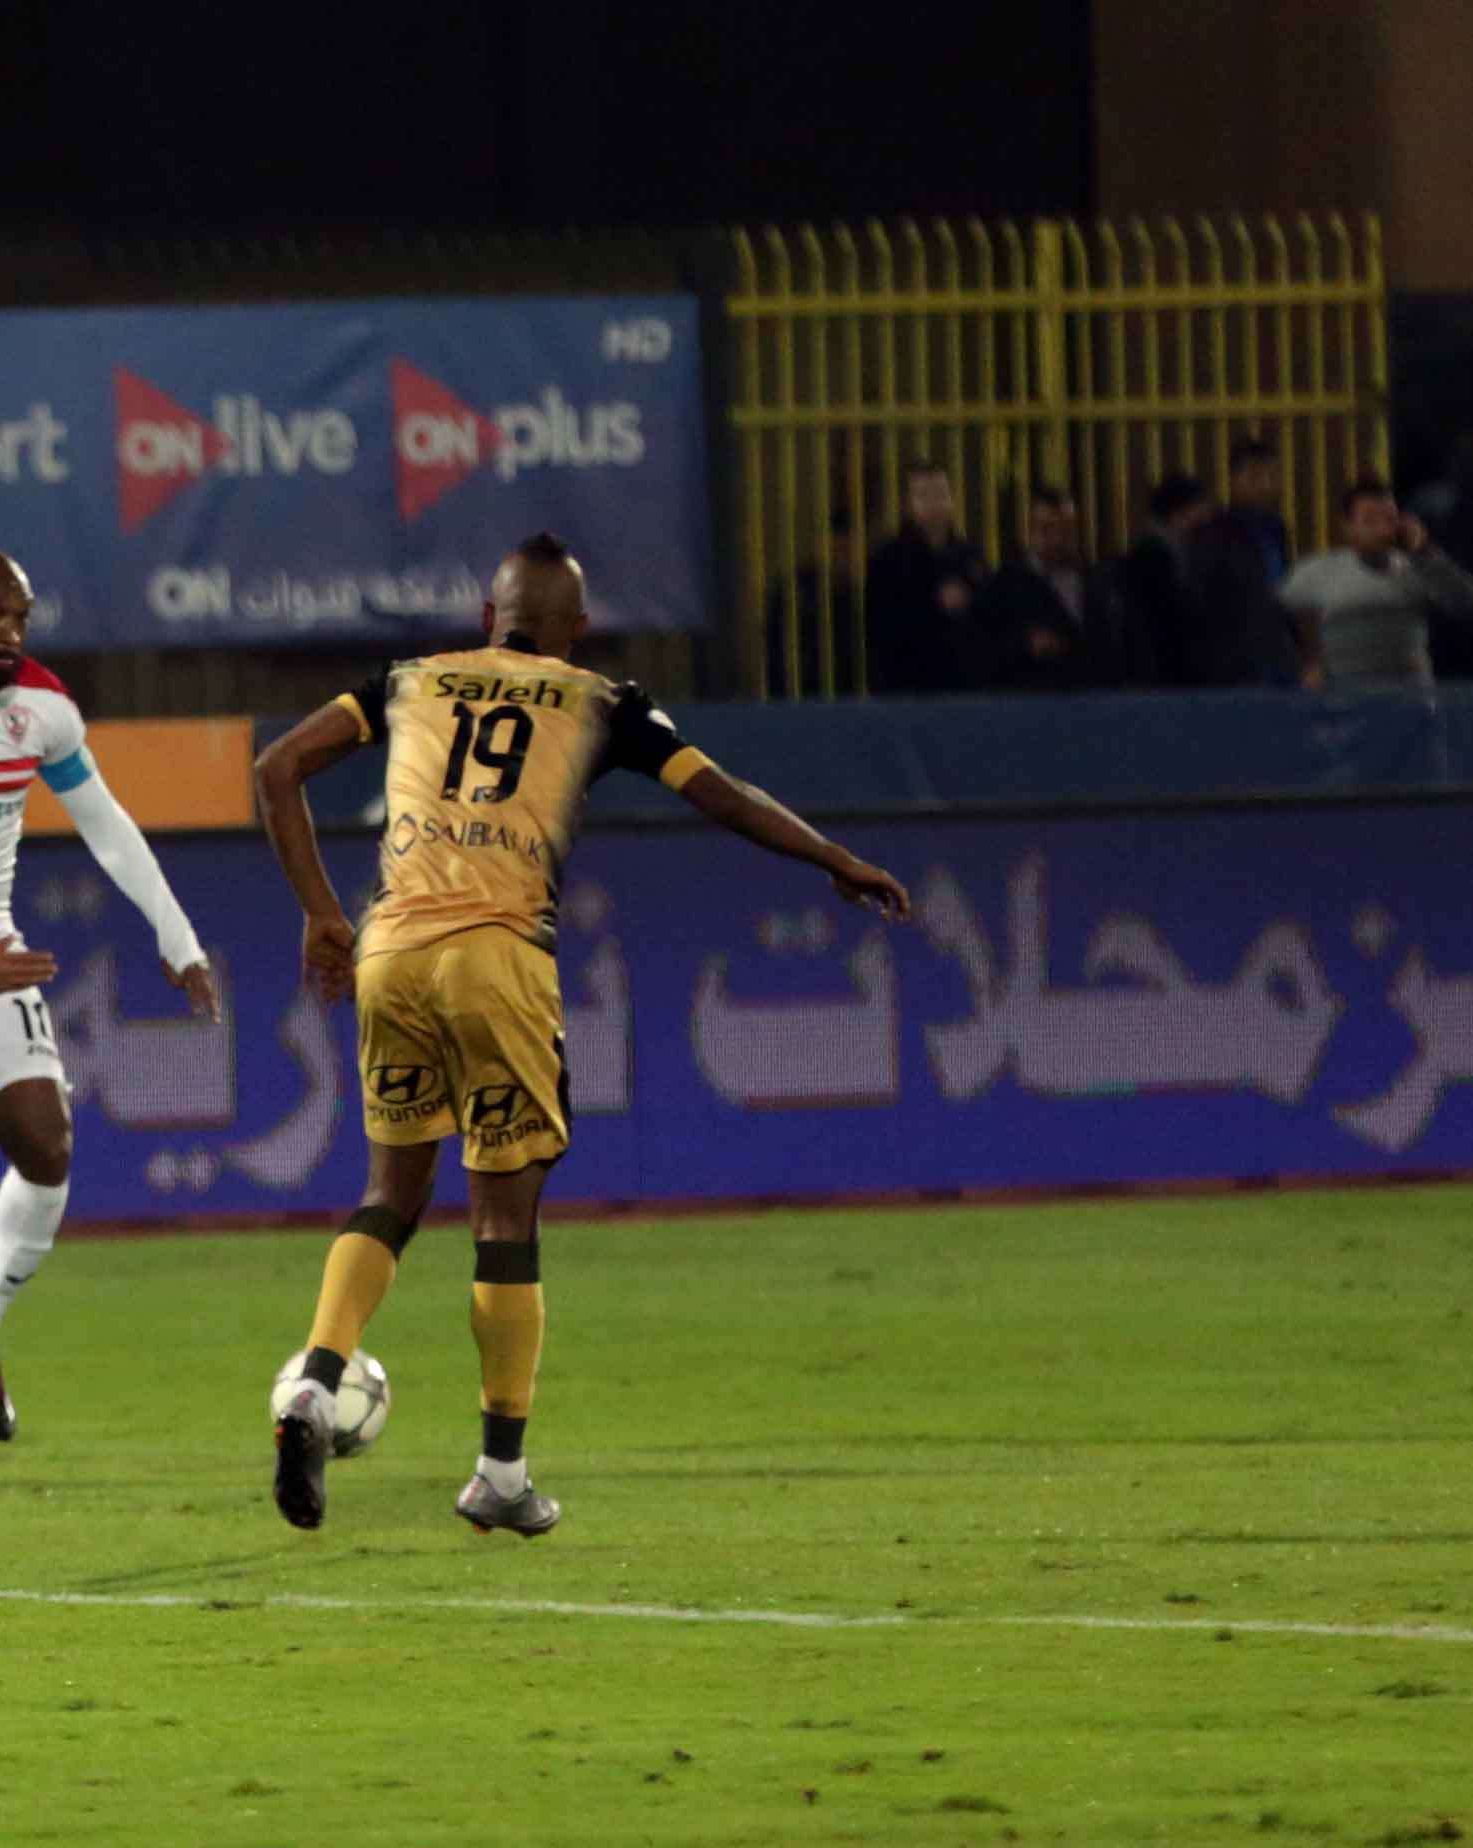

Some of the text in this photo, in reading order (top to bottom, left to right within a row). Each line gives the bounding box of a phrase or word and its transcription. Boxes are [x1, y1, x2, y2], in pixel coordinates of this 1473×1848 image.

[603, 318, 673, 363] HD
[123, 421, 204, 476] ON
[397, 384, 646, 483] ON plus
[149, 564, 231, 620] ON
[435, 672, 564, 709] Saleh
[439, 700, 535, 803] 19
